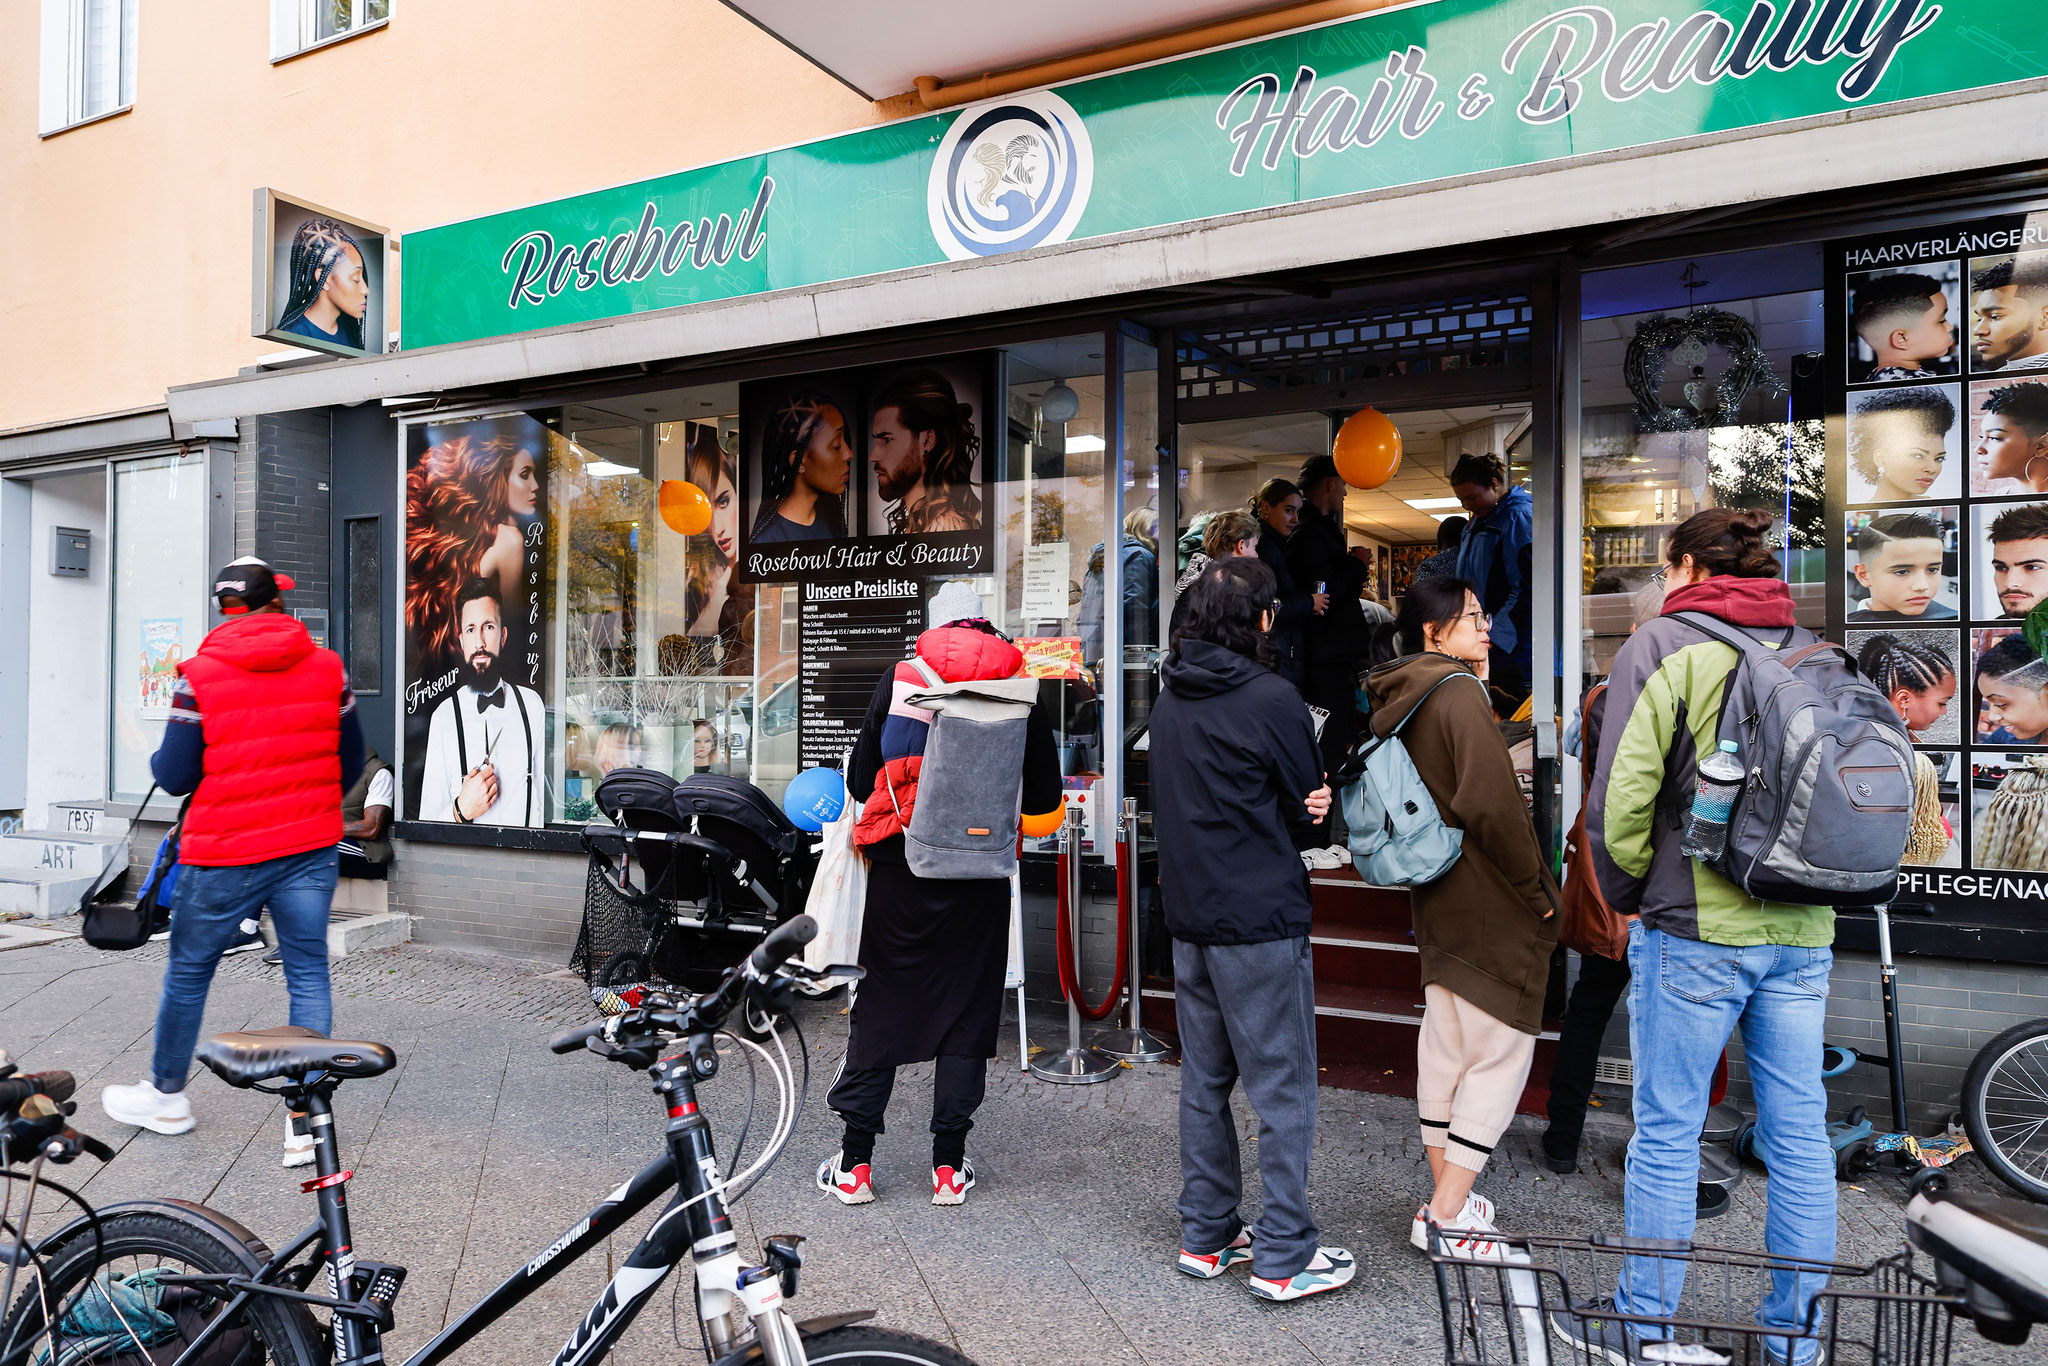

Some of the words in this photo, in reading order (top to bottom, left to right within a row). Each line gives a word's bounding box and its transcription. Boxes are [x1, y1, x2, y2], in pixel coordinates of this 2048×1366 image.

[1218, 44, 1444, 178] Hair
[1457, 72, 1494, 121] &
[502, 176, 775, 309] Rosebowl
[749, 544, 836, 577] Rosebowl
[836, 544, 882, 569] Hair
[885, 540, 907, 567] &
[911, 541, 983, 569] Beauty
[524, 522, 543, 685] Rosebowl
[806, 583, 851, 600] Unsere
[855, 578, 918, 598] Preisliste
[1045, 643, 1065, 655] PROMO
[406, 667, 459, 714] Friseur
[42, 844, 76, 869] ART
[1897, 873, 2048, 900] PFLEGE/NA
[527, 1217, 591, 1277] CROSSWIND
